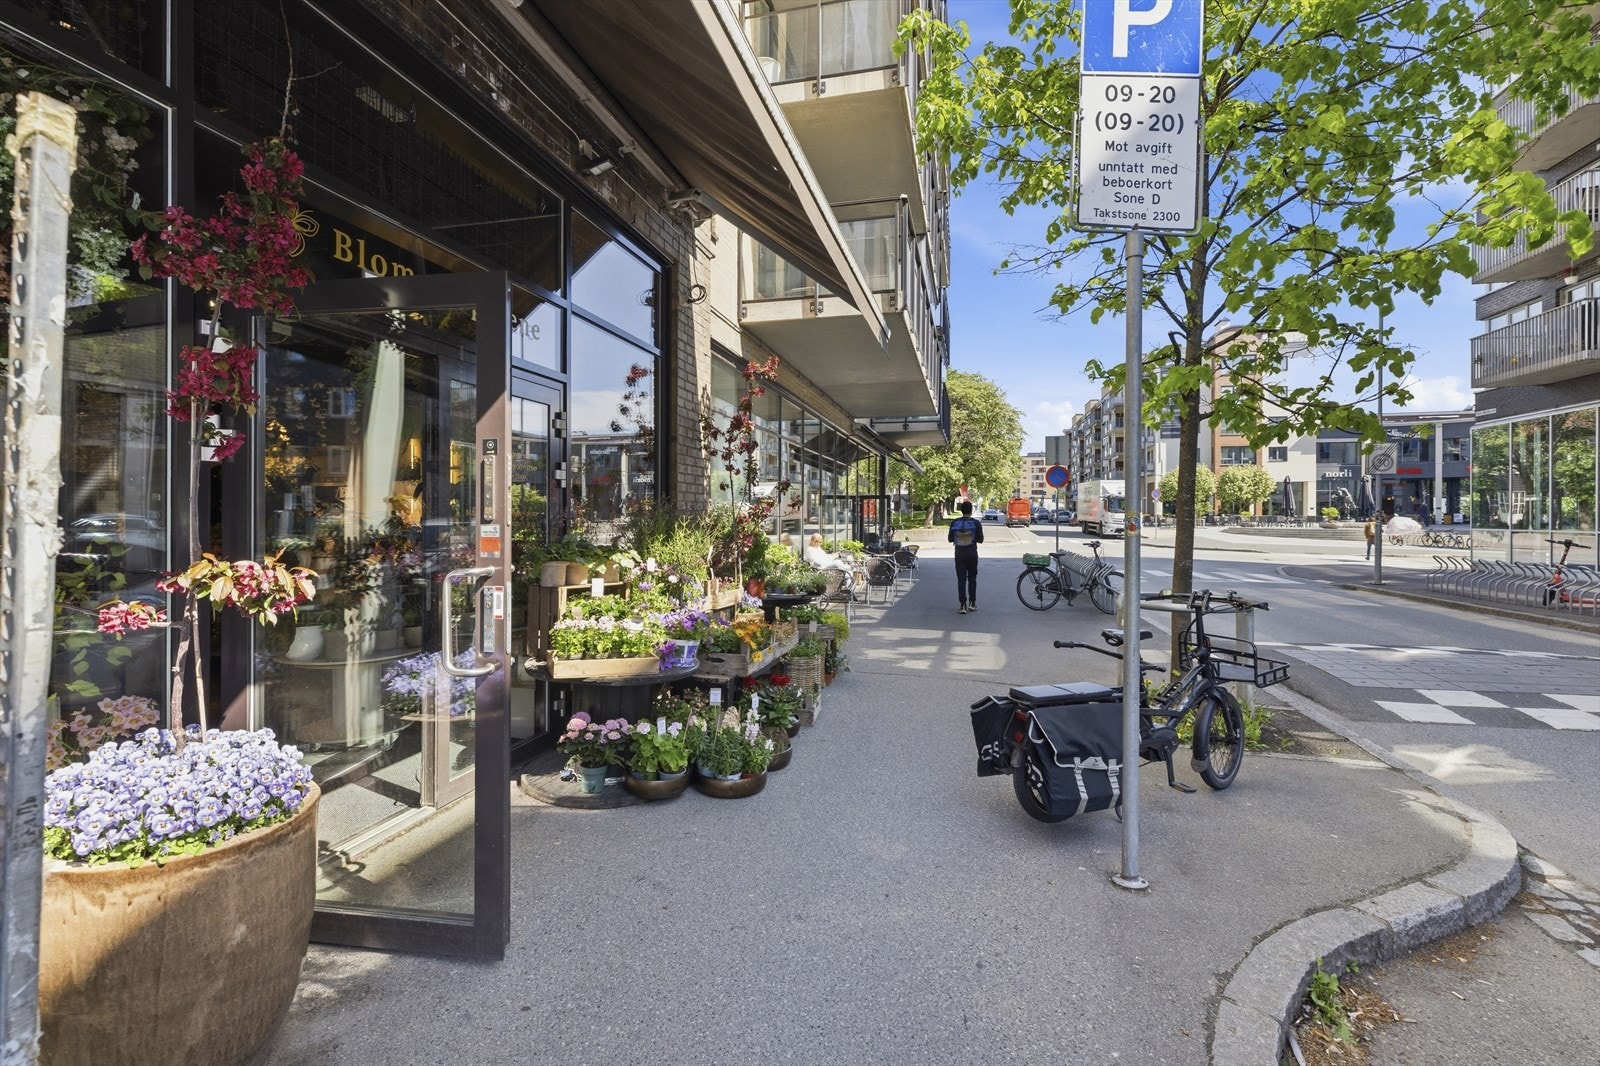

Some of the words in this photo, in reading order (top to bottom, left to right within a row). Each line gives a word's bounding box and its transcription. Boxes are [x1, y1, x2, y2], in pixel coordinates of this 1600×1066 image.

[1113, 0, 1173, 57] P
[1105, 84, 1176, 104] 09-20
[1095, 111, 1184, 135] (09-20)
[1105, 140, 1128, 152] Mot
[1135, 142, 1172, 156] avgift
[1098, 161, 1144, 174] unntatt
[1151, 163, 1178, 175] med
[1102, 175, 1173, 190] beboerkort
[1114, 192, 1145, 204] Sone
[1152, 194, 1161, 205] D
[1093, 207, 1147, 220] Takstsone
[1153, 211, 1181, 222] 2300
[1325, 469, 1353, 478] norli
